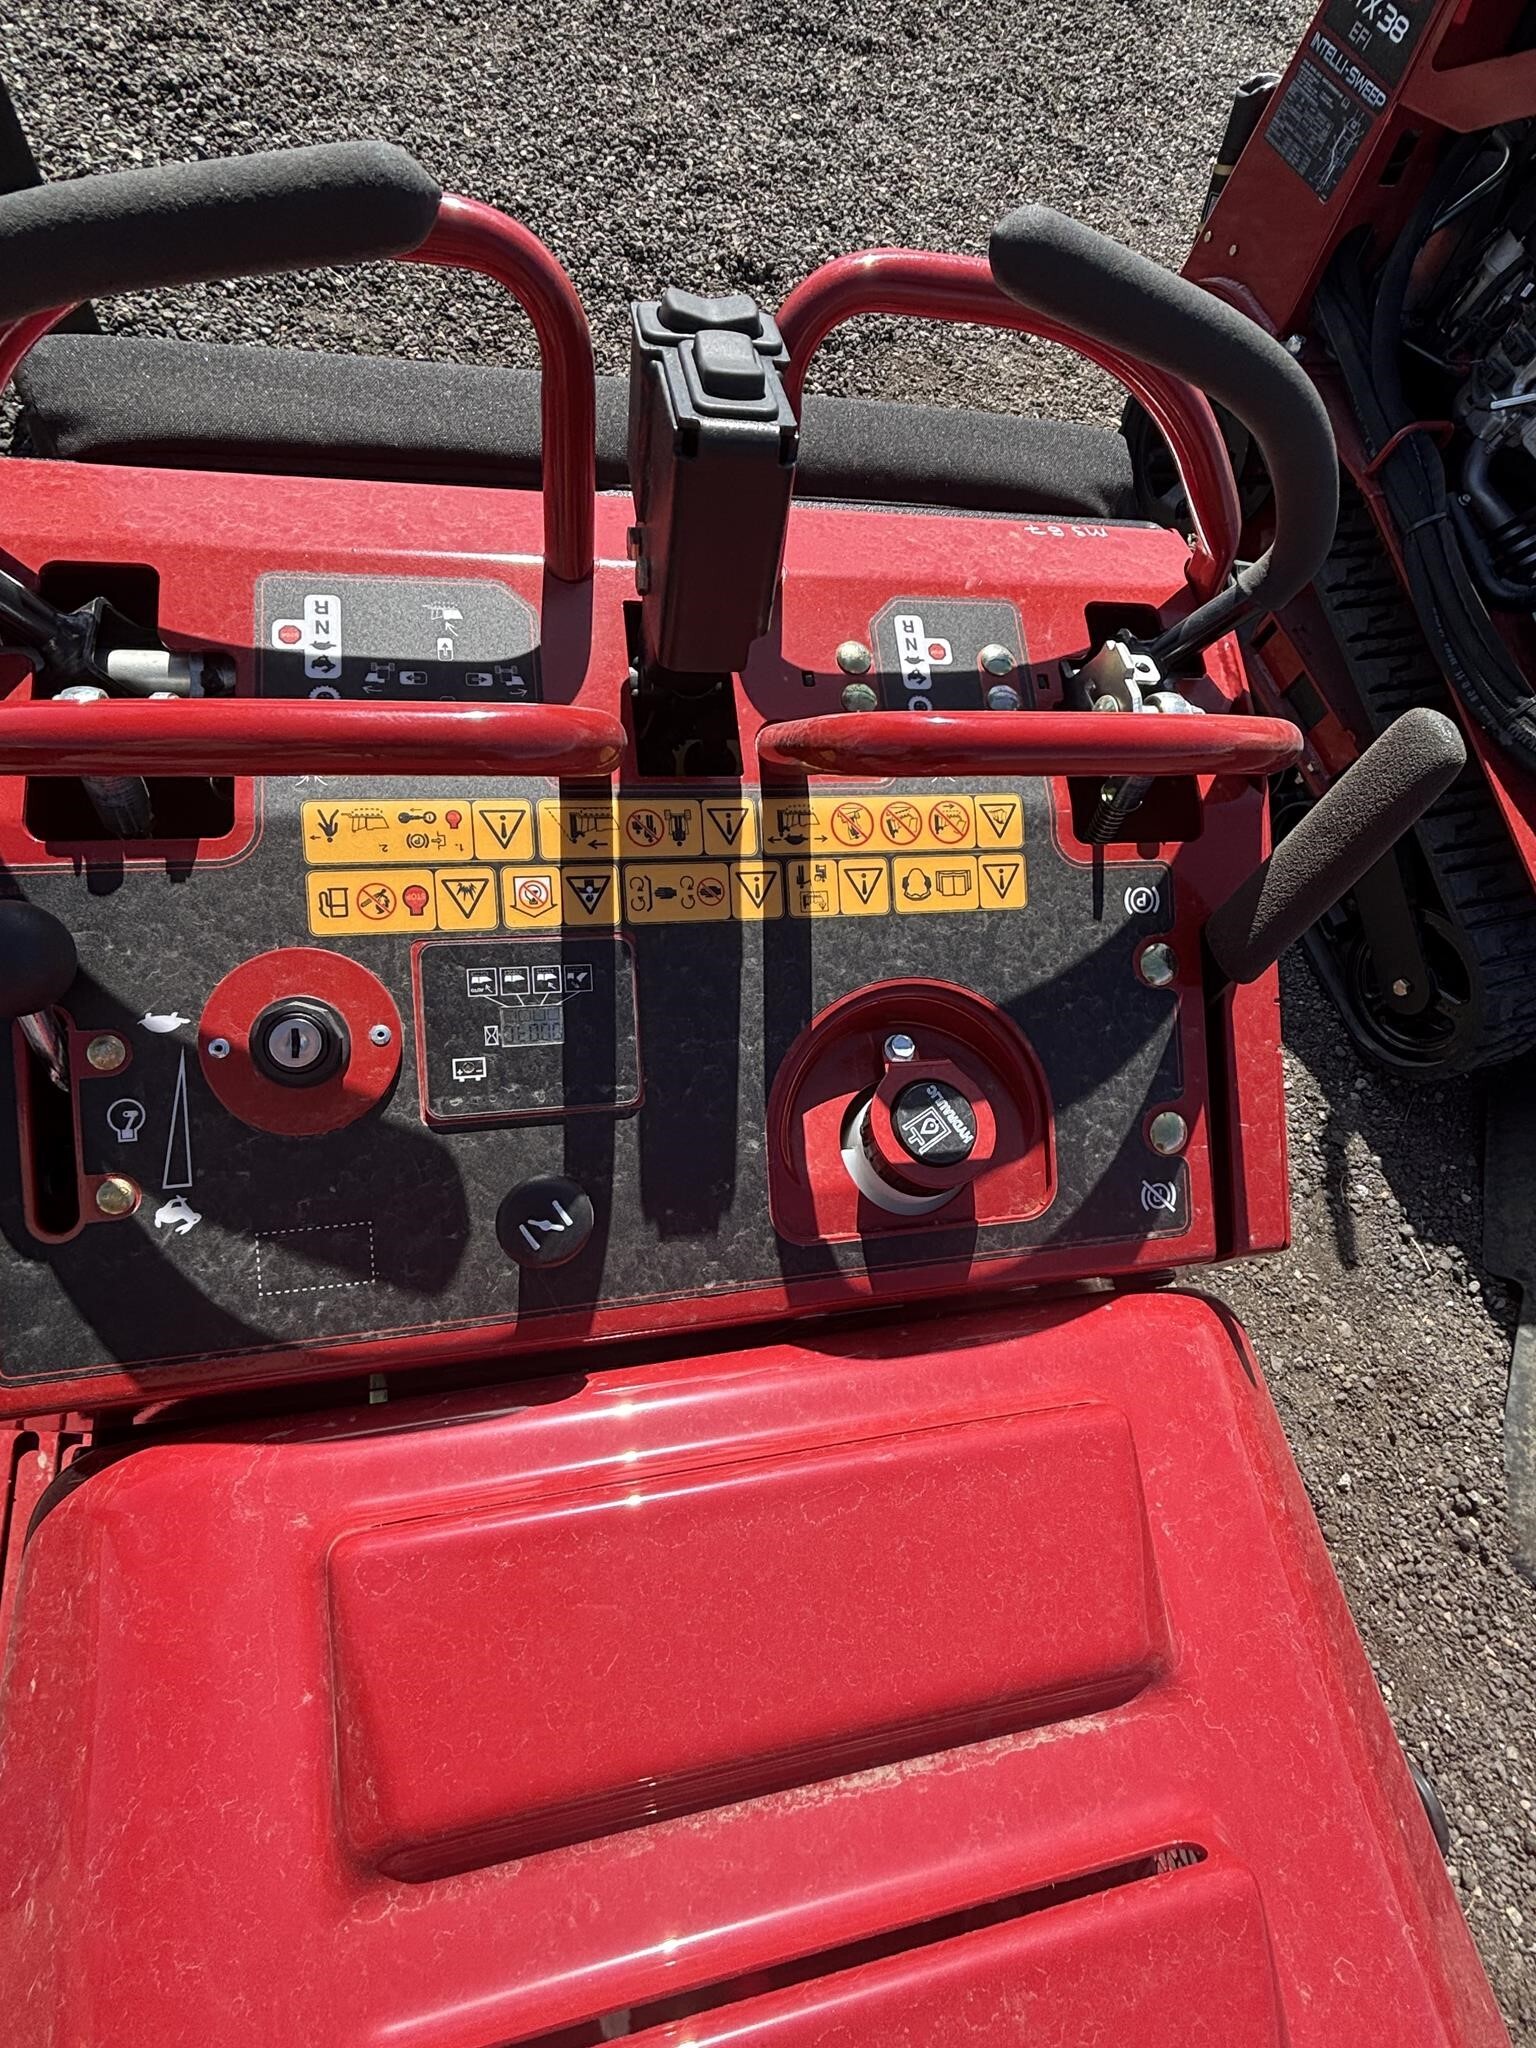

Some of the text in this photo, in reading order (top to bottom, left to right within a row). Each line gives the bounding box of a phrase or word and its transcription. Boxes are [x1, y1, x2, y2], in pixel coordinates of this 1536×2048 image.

[1348, 20, 1372, 51] EFI
[314, 600, 329, 615] R
[314, 620, 330, 635] N
[902, 619, 915, 633] R
[904, 637, 918, 651] N
[926, 1084, 975, 1144] HYDRAULIC
